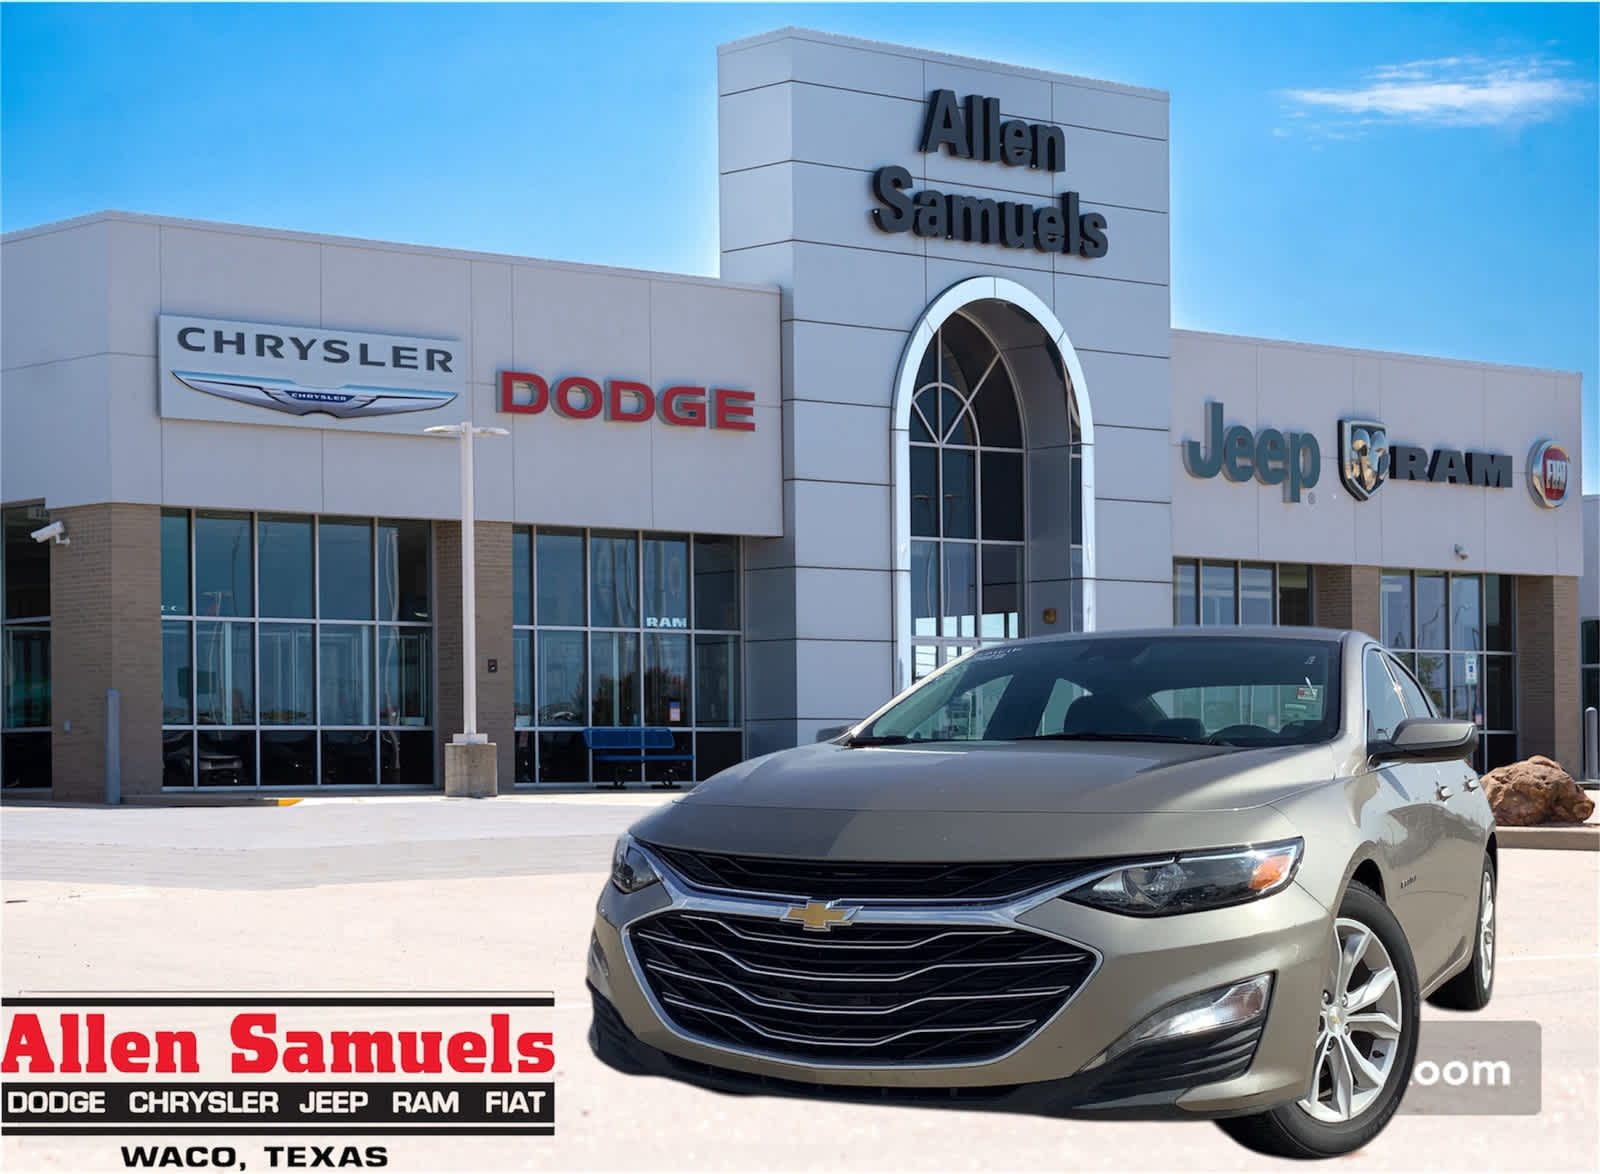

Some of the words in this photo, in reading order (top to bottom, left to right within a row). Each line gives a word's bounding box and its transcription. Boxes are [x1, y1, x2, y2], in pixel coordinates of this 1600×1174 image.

[919, 89, 1065, 172] Allen
[872, 165, 1108, 258] Samuels
[177, 327, 453, 372] CHRYSLER
[291, 392, 347, 401] CHRYSLER
[497, 370, 755, 432] DODGE
[1183, 401, 1321, 503] Jeep
[1389, 445, 1513, 488] RAM
[646, 617, 688, 628] RAM
